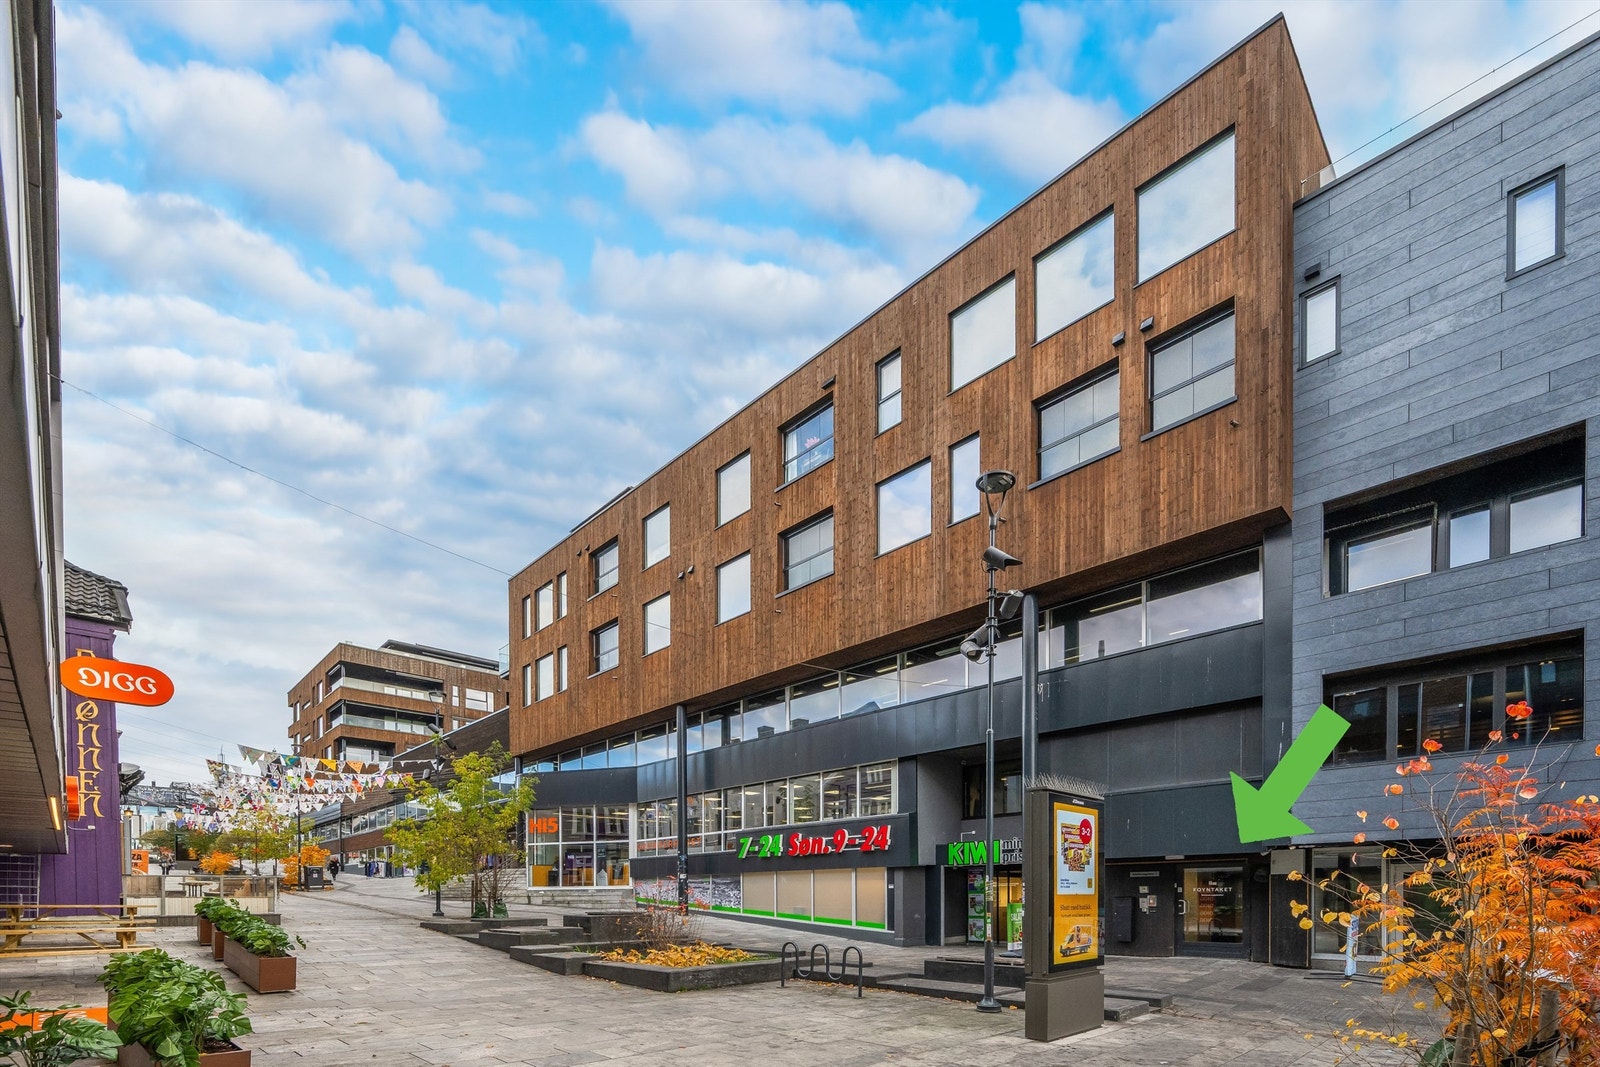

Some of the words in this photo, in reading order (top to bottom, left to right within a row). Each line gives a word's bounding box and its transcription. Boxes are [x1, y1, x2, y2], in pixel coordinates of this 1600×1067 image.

[78, 667, 157, 695] DIGG
[528, 817, 559, 834] Hi5
[1081, 827, 1091, 836] 3-2
[738, 834, 783, 859] 7-24
[788, 832, 831, 857] Søn.
[833, 825, 891, 852] 9-24
[947, 839, 1001, 865] KIWI
